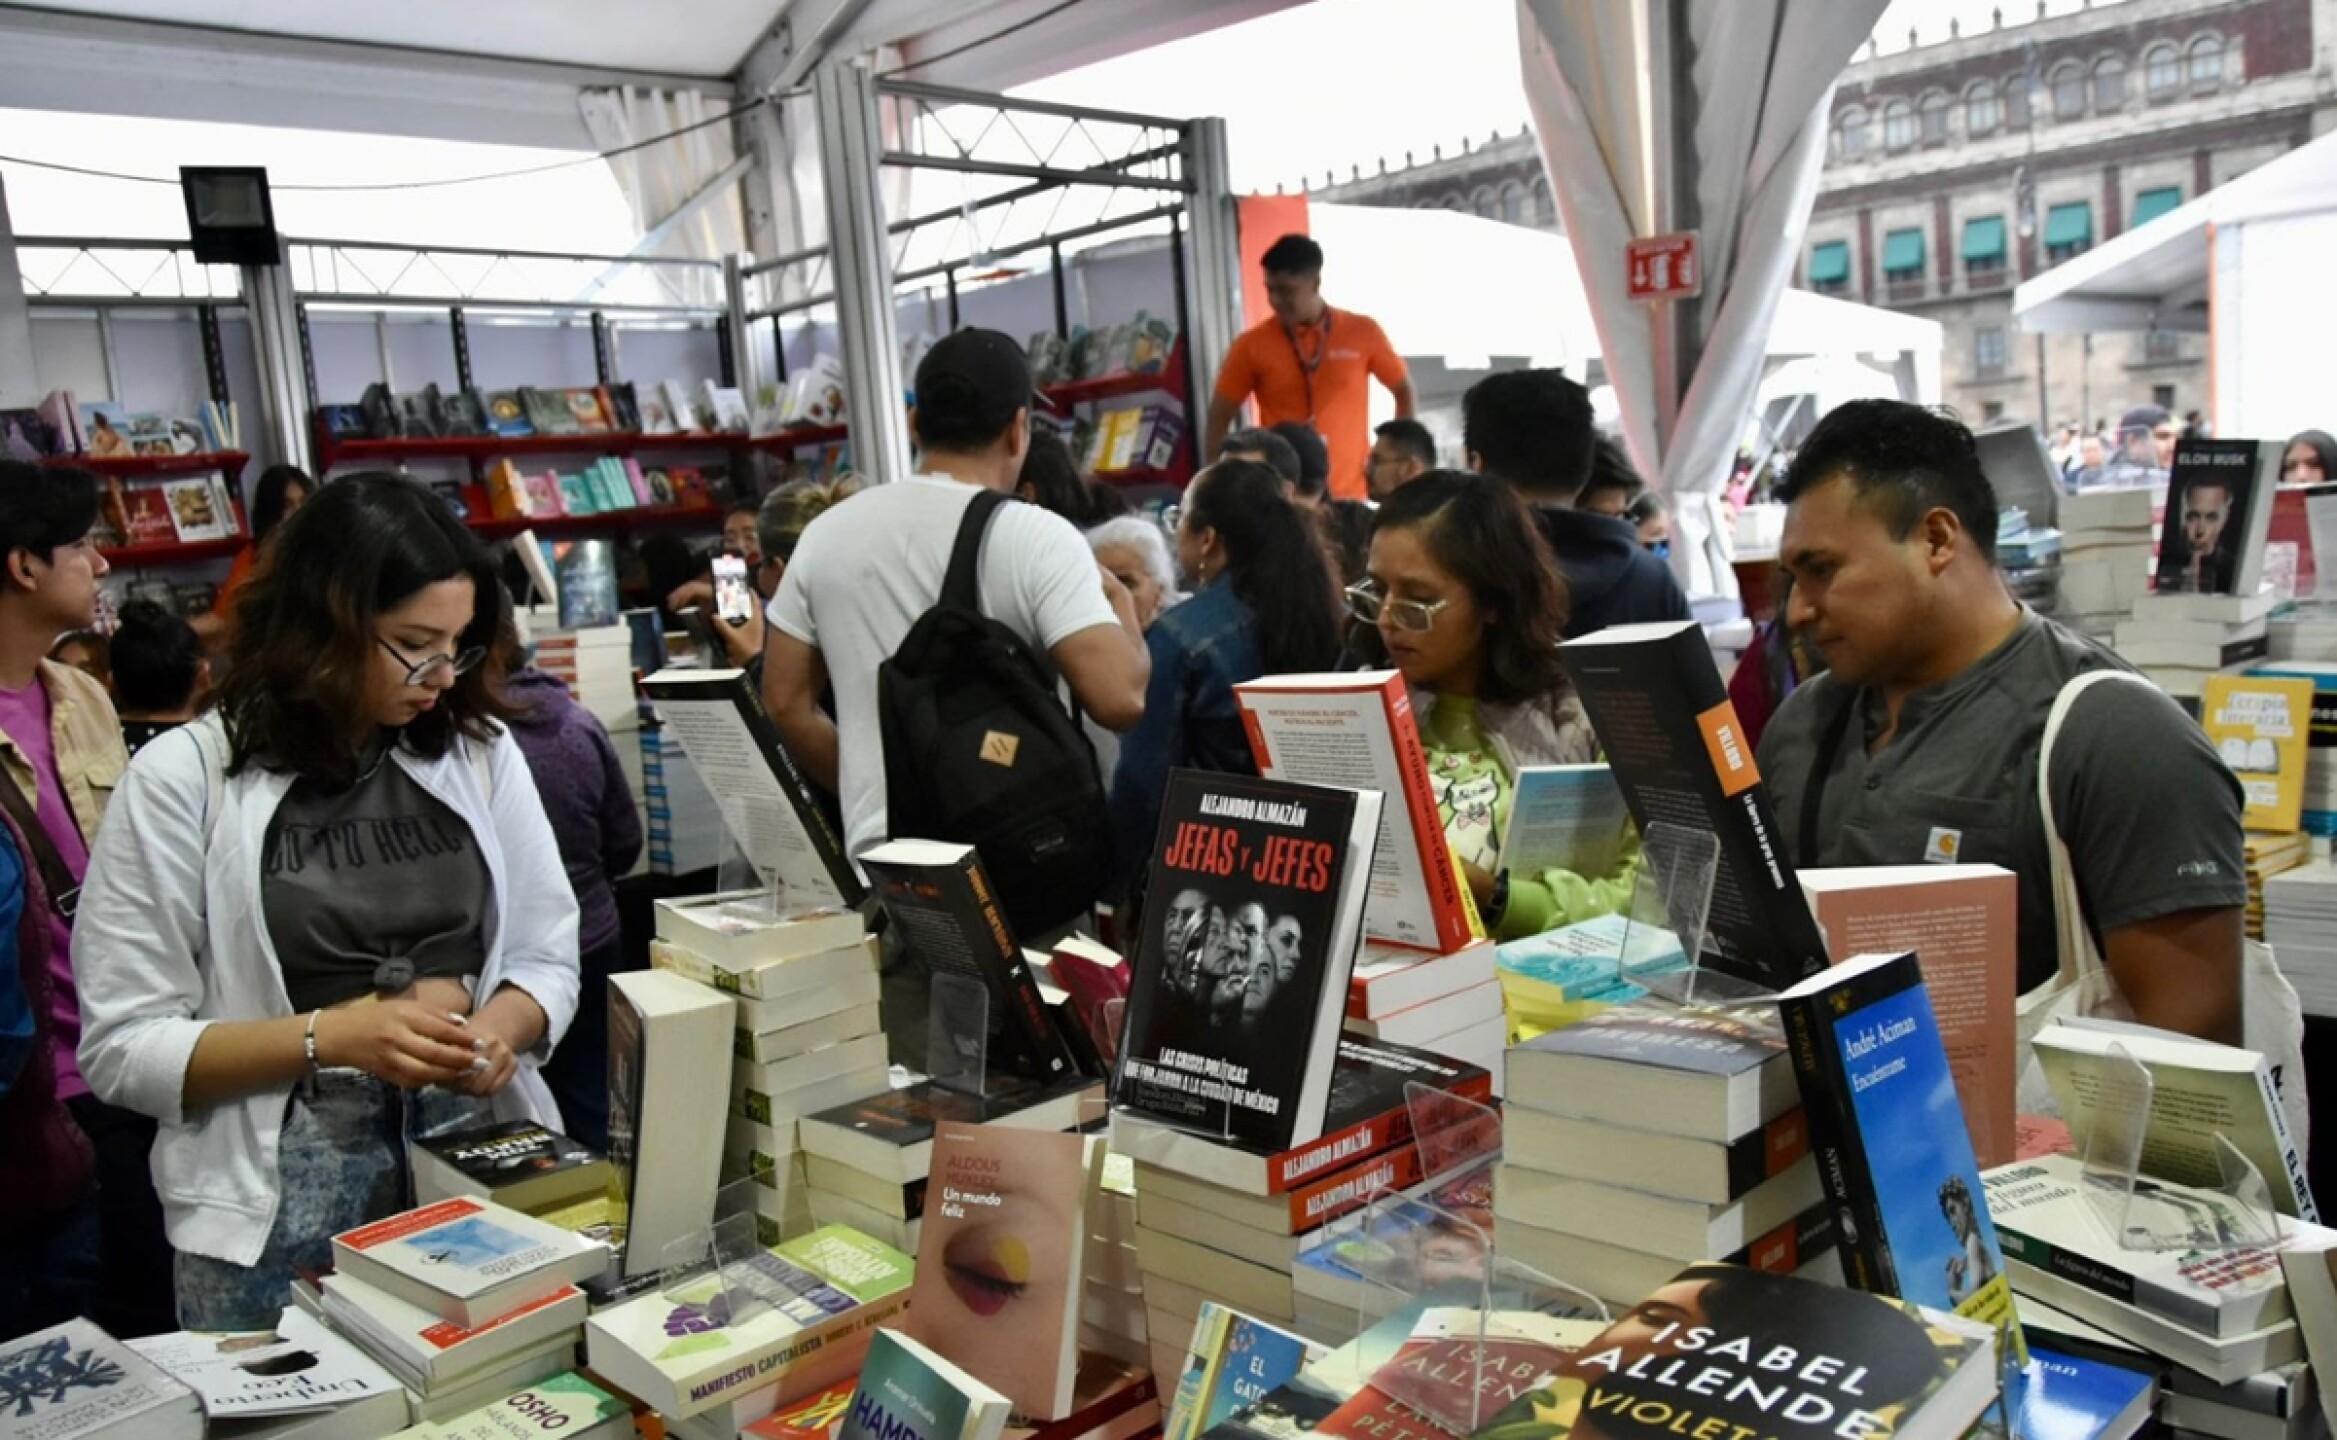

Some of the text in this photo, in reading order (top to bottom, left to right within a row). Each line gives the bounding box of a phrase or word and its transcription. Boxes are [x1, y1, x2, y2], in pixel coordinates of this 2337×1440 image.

[2177, 453, 2247, 465] ELON MUSK
[1200, 794, 1307, 827] ALEJANDRO ALMAZÁN
[313, 821, 366, 871] TO
[370, 815, 464, 865] HELL
[1165, 821, 1333, 892] JEFAS Y JEFES
[1844, 1027, 1878, 1061] André
[1877, 1017, 1917, 1046] Aciman
[946, 1155, 1000, 1173] ALDOUS
[1283, 1144, 1333, 1181] ALEJANDRO
[1332, 1126, 1373, 1158] ALMAZÁN
[941, 1201, 965, 1218] feliz
[943, 1186, 1001, 1206] Un mundo
[1306, 1161, 1395, 1218] ALEJANDRO ALMAZÁN
[690, 1364, 756, 1402] MANIFIESTO
[758, 1335, 822, 1374] CAPITALISTA
[1249, 1355, 1265, 1377] EL
[1402, 1356, 1526, 1401] ALLEN
[1447, 1343, 1550, 1387] ISAB
[1650, 1320, 1870, 1397] ISABEL
[213, 1377, 370, 1406] Umberto
[242, 1373, 316, 1391] Eco
[1577, 1345, 1886, 1438] ALLENDE
[507, 1392, 570, 1430] OSHO
[854, 1389, 926, 1440] HAM
[1587, 1388, 1780, 1440] VIOLET
